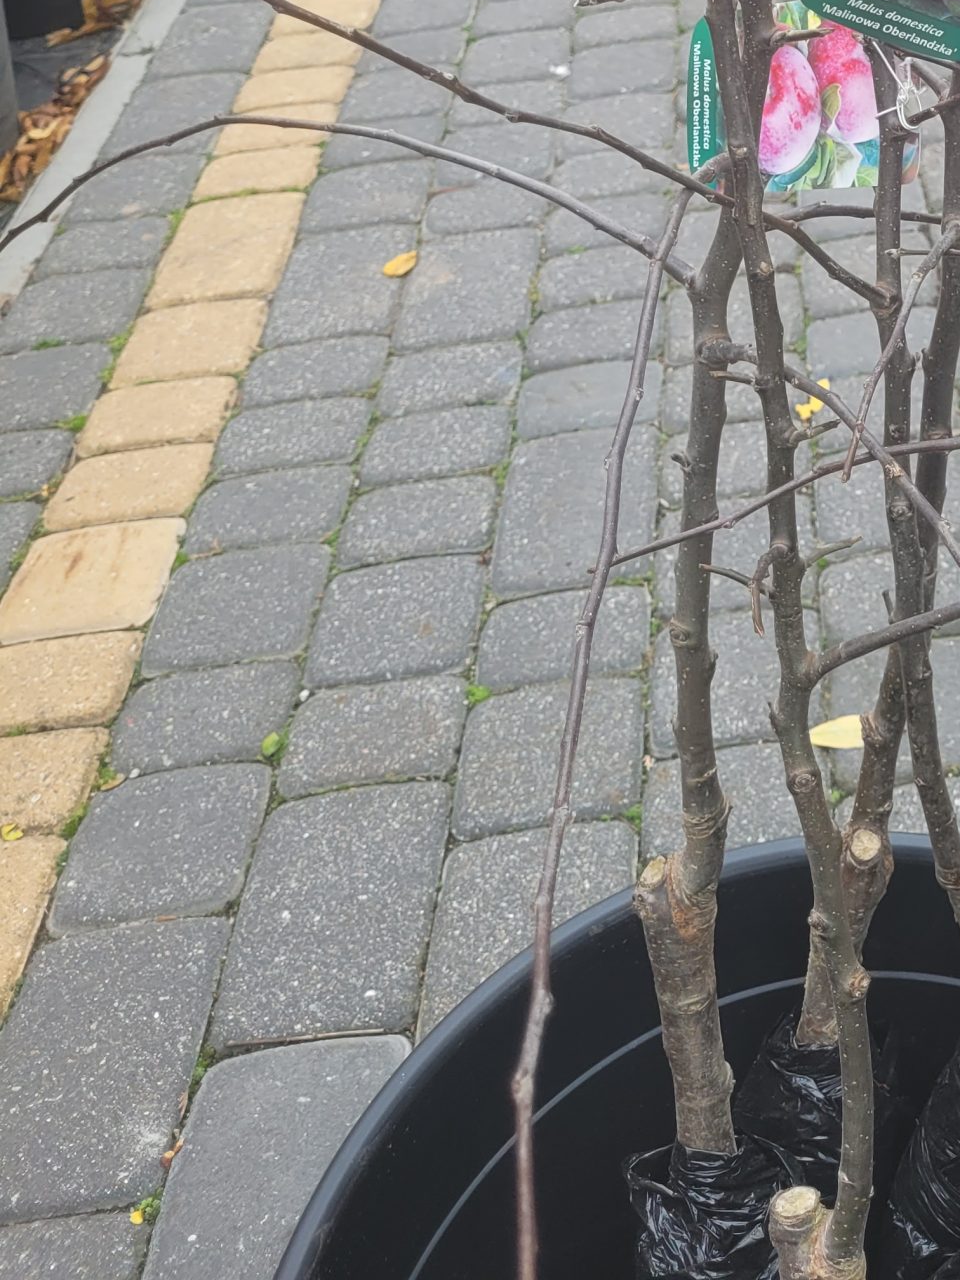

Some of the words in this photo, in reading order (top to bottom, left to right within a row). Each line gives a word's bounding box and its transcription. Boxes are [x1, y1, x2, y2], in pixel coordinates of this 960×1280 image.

[822, 3, 880, 30] 'Malinowa
[883, 24, 958, 56] Oberlandzka'
[885, 9, 945, 38] domestica
[693, 41, 701, 97] 'Malinowa
[704, 59, 712, 92] Malus
[693, 100, 701, 170] Oberlandzka'
[703, 94, 712, 150] domestica
